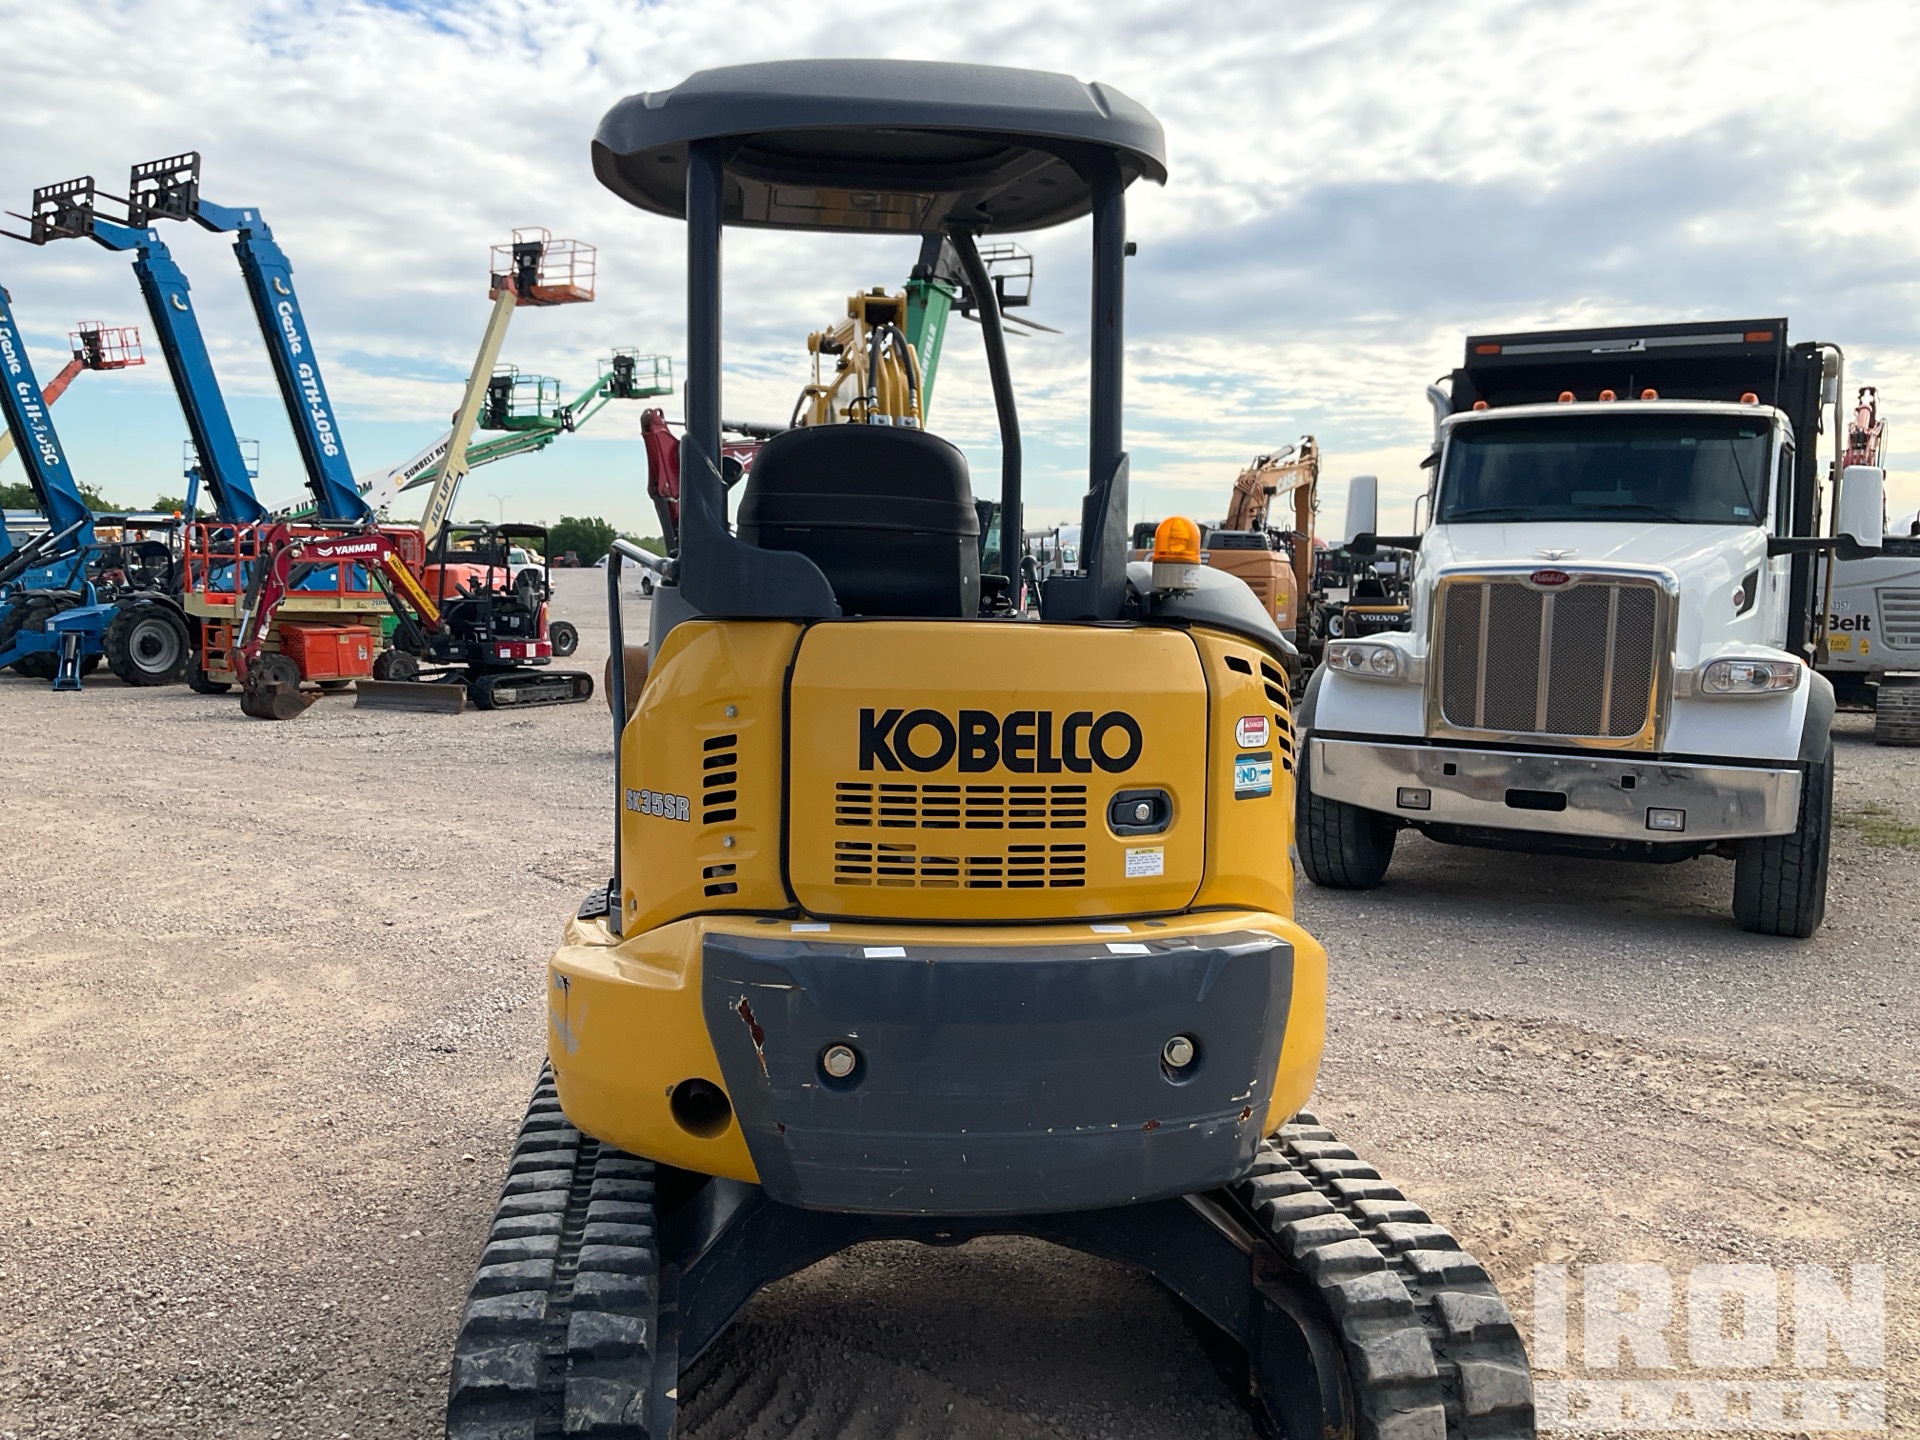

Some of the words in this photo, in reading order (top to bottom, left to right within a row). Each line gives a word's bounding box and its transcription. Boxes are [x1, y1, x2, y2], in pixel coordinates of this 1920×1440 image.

[0, 327, 22, 377] Genie
[278, 301, 302, 358] Genie
[298, 363, 339, 457] GTH-1056
[403, 453, 436, 480] SUNBELT
[436, 441, 450, 458] REN
[430, 505, 443, 528] JLG
[442, 470, 454, 501] LIFT
[1276, 471, 1298, 494] CASE
[335, 543, 377, 555] YANMAR
[1360, 614, 1399, 623] VOLVO
[858, 707, 1143, 774] KOBELCO
[625, 787, 691, 823] SK35SR
